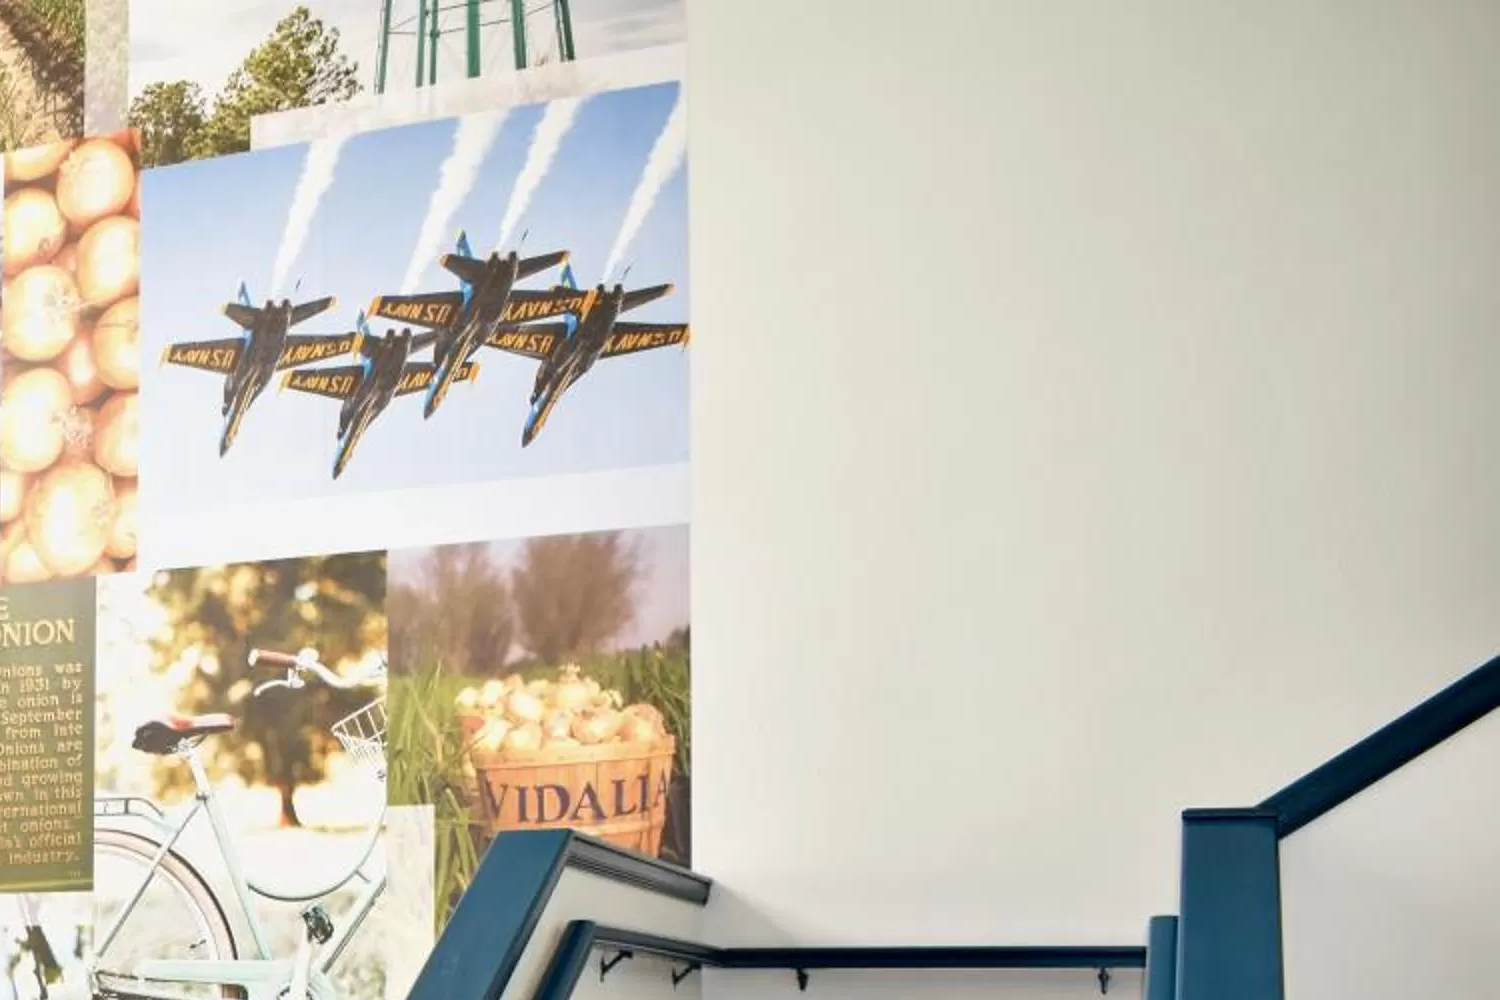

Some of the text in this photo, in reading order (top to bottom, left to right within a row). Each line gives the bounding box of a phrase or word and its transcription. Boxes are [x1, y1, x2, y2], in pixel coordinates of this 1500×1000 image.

[54, 663, 84, 675] was
[20, 677, 49, 692] 1931
[62, 677, 83, 692] by
[17, 694, 59, 708] onion
[71, 691, 83, 704] is
[1, 708, 83, 726] September
[6, 726, 41, 739] from
[54, 723, 83, 737] late
[56, 740, 83, 753] are
[67, 753, 83, 767] of
[21, 771, 83, 788] growing
[35, 788, 49, 801] in
[55, 785, 83, 800] this
[484, 767, 668, 824] VIDALIA
[29, 831, 81, 849] official
[8, 850, 80, 866] industry.
